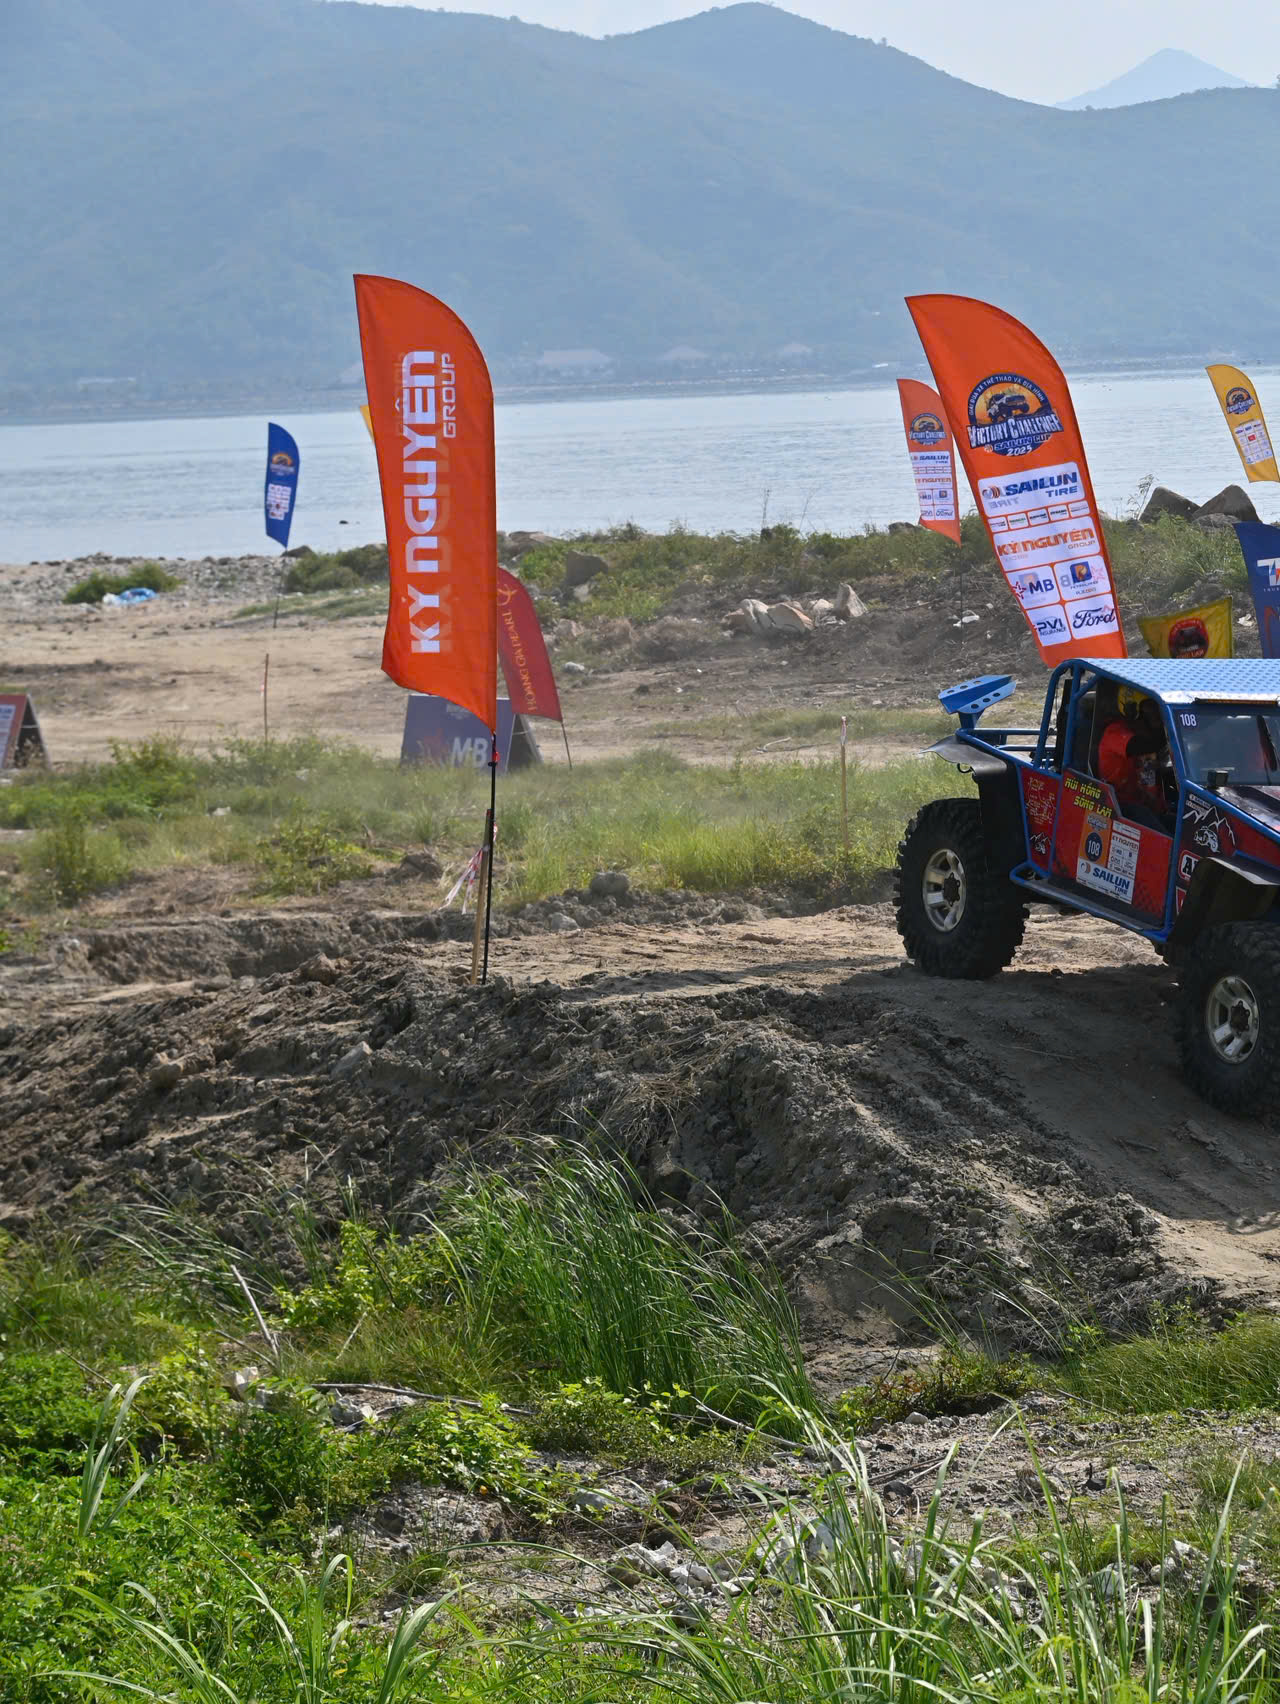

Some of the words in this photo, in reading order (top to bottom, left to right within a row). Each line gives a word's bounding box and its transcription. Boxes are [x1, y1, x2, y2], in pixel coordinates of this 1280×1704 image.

[441, 352, 456, 438] GROUP
[967, 422, 1009, 448] VICTORY
[1008, 414, 1061, 439] CHALLENGE
[1006, 445, 1033, 457] 2025
[395, 351, 438, 573] NGUYÊN
[1005, 472, 1078, 497] SAILUN
[1045, 486, 1078, 498] TIRE
[1067, 541, 1096, 550] GROUP
[1028, 579, 1054, 594] MB
[1036, 618, 1063, 632] PVI
[1072, 607, 1116, 629] Ford
[1180, 713, 1197, 726] 108
[452, 736, 490, 768] MB
[1087, 839, 1101, 856] 108
[1092, 867, 1130, 890] SAILUN
